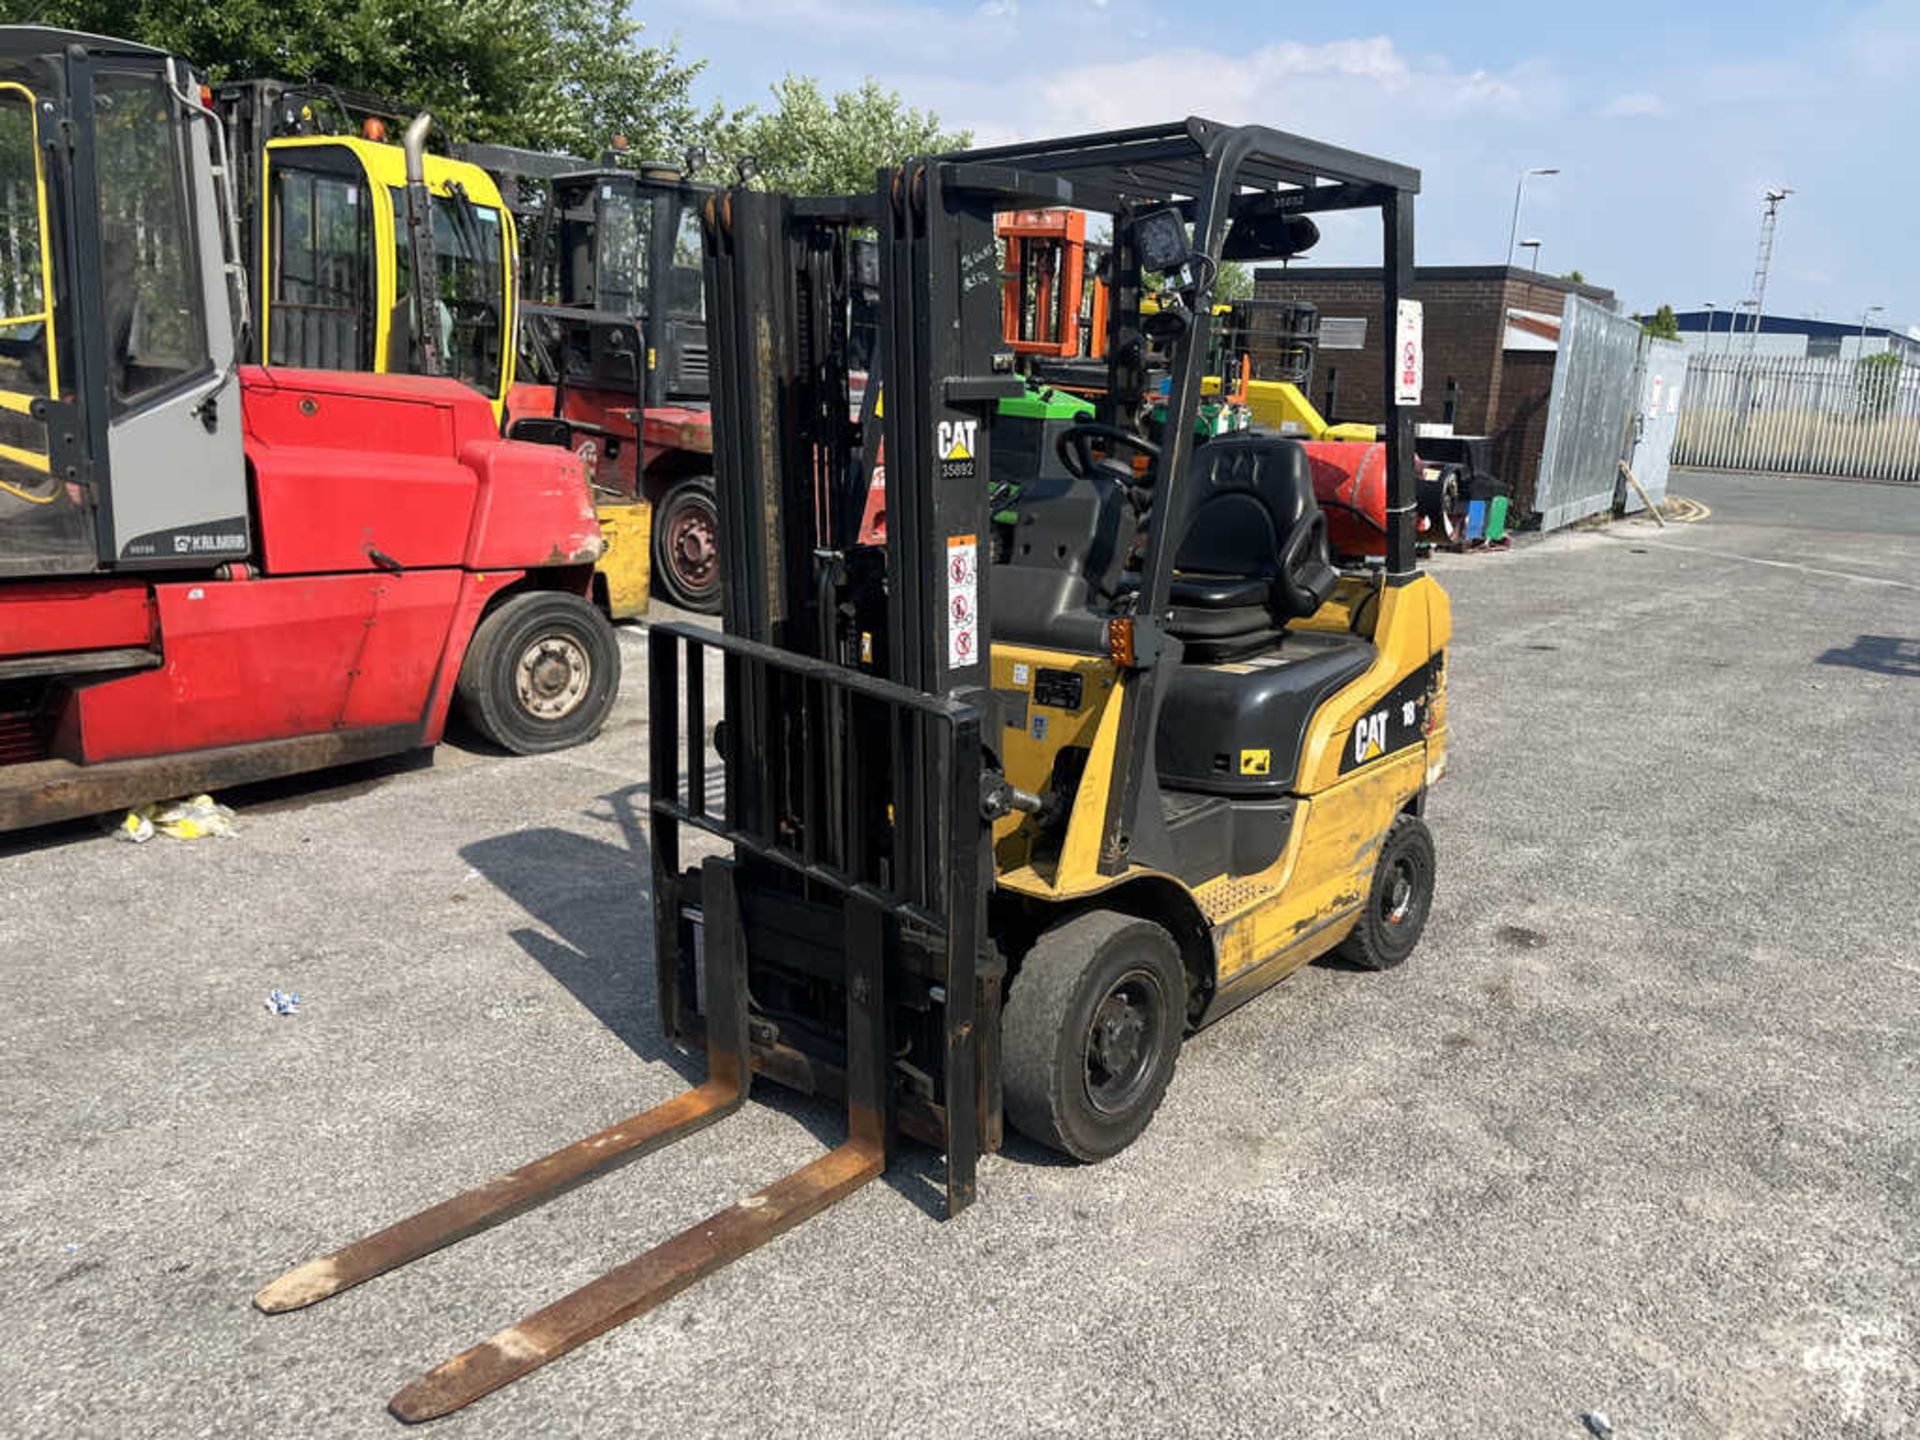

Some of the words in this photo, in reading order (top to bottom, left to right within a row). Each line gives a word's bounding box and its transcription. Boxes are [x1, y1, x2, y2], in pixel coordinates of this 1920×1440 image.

[937, 420, 977, 460] CAT
[1355, 709, 1389, 764] CAT
[1402, 700, 1415, 727] 18
